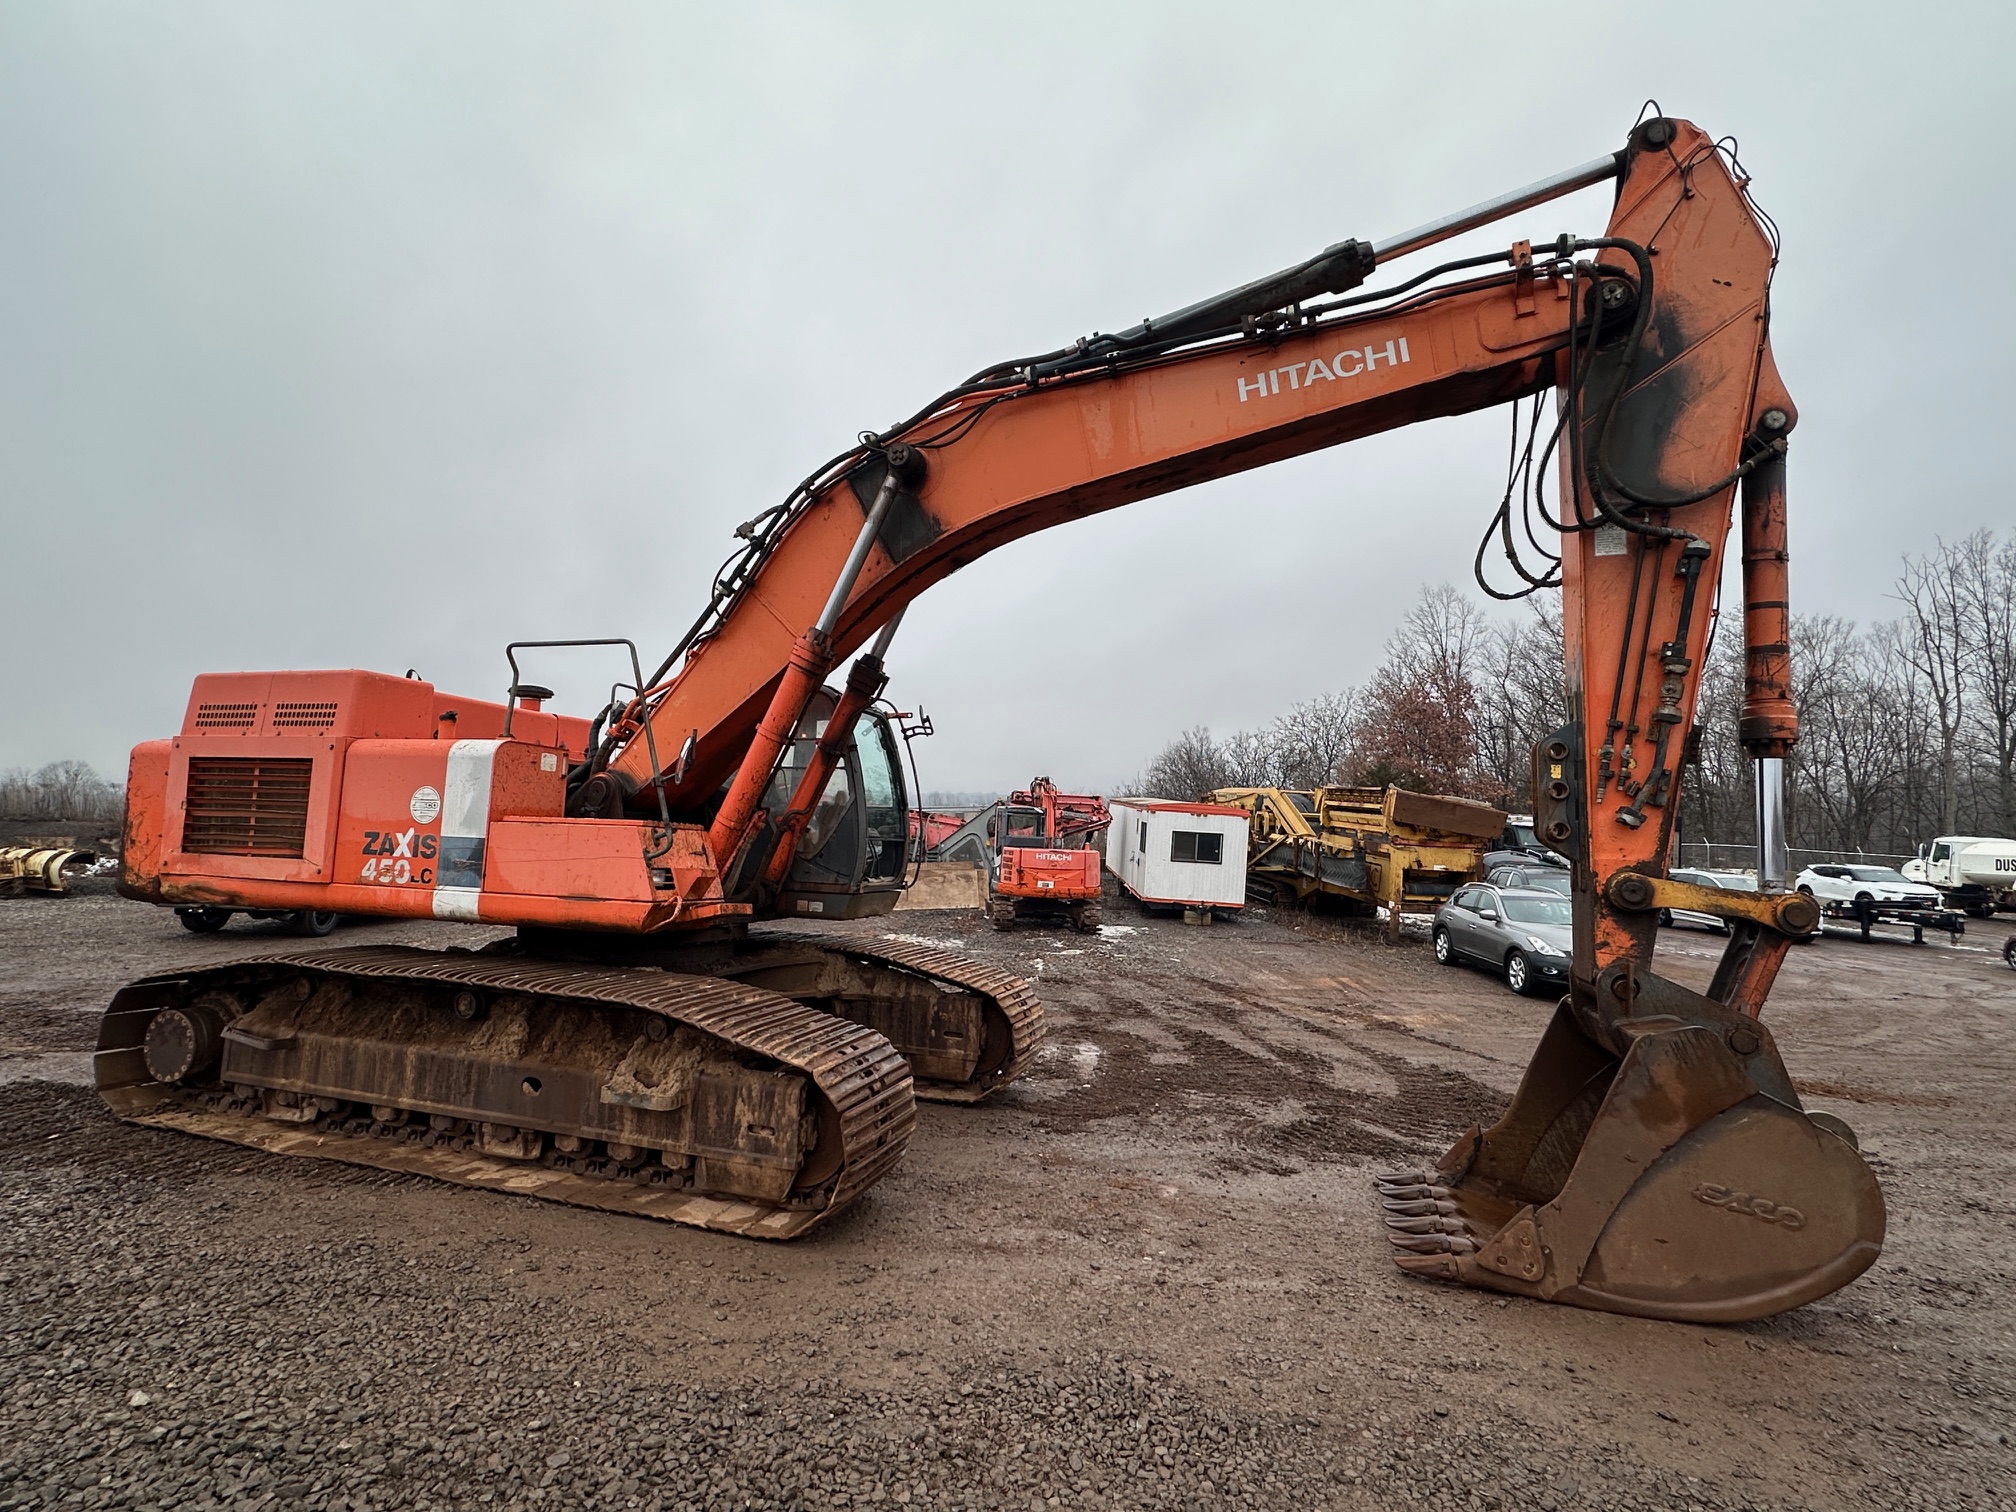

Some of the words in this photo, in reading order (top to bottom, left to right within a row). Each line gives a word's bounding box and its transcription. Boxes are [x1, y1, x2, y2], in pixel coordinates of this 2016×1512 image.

[1237, 336, 1411, 403] HITACHI
[362, 827, 438, 859] ZAXIS
[1035, 852, 1072, 861] HITACHI
